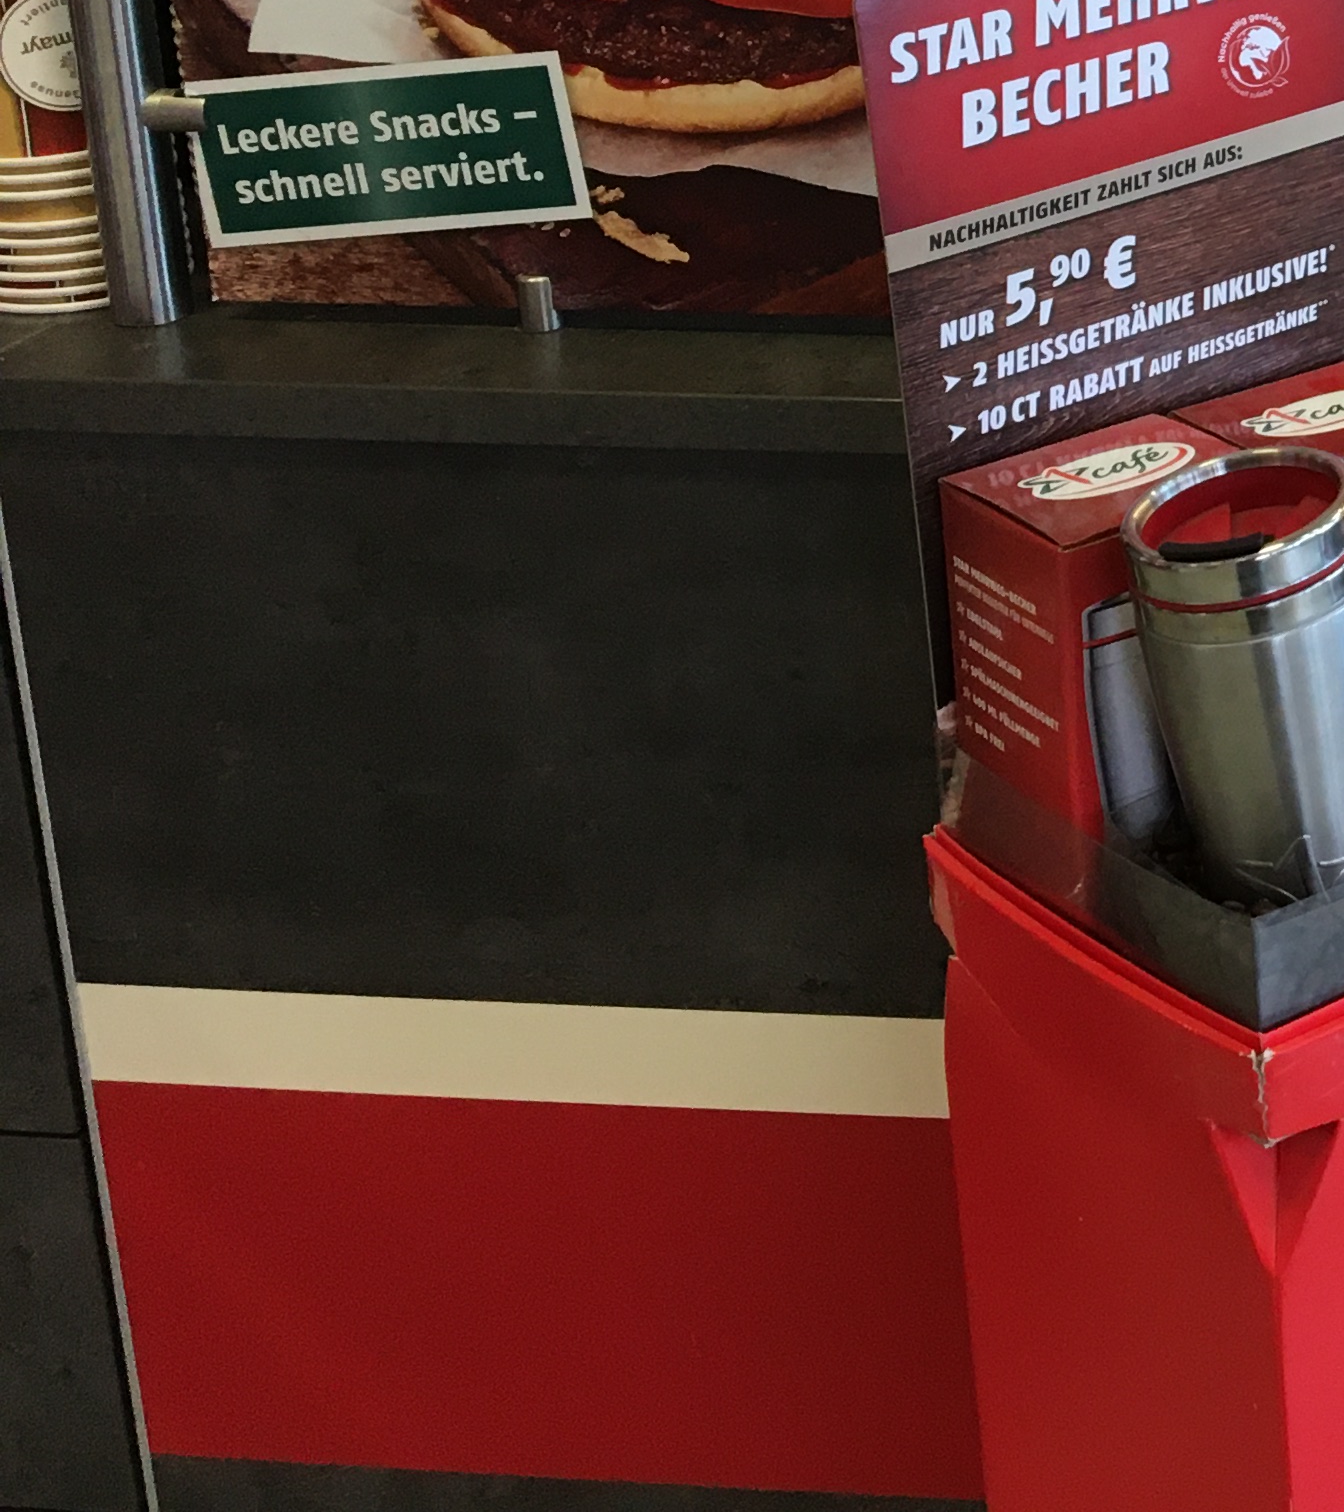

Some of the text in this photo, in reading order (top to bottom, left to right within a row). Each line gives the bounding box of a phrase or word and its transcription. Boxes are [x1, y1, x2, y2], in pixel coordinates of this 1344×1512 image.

[890, 8, 1013, 84] STAR
[1218, 17, 1247, 63] Nachhaltig
[216, 101, 501, 156] Leckere Snacks
[962, 41, 1170, 148] BECHER
[234, 149, 545, 206] schnell serviert.
[929, 145, 1244, 252] NACHHALTIGKEIT ZAHLT SICH AUS:
[940, 308, 995, 350] NUR
[1103, 235, 1137, 290] €
[972, 361, 988, 388] 2
[997, 295, 1195, 381] HEISSGETRÄNKE
[977, 403, 1005, 434] 10
[1010, 391, 1039, 422] CT
[1049, 356, 1145, 412] RABATT
[1148, 352, 1183, 377] AUF
[1092, 447, 1169, 479] café
